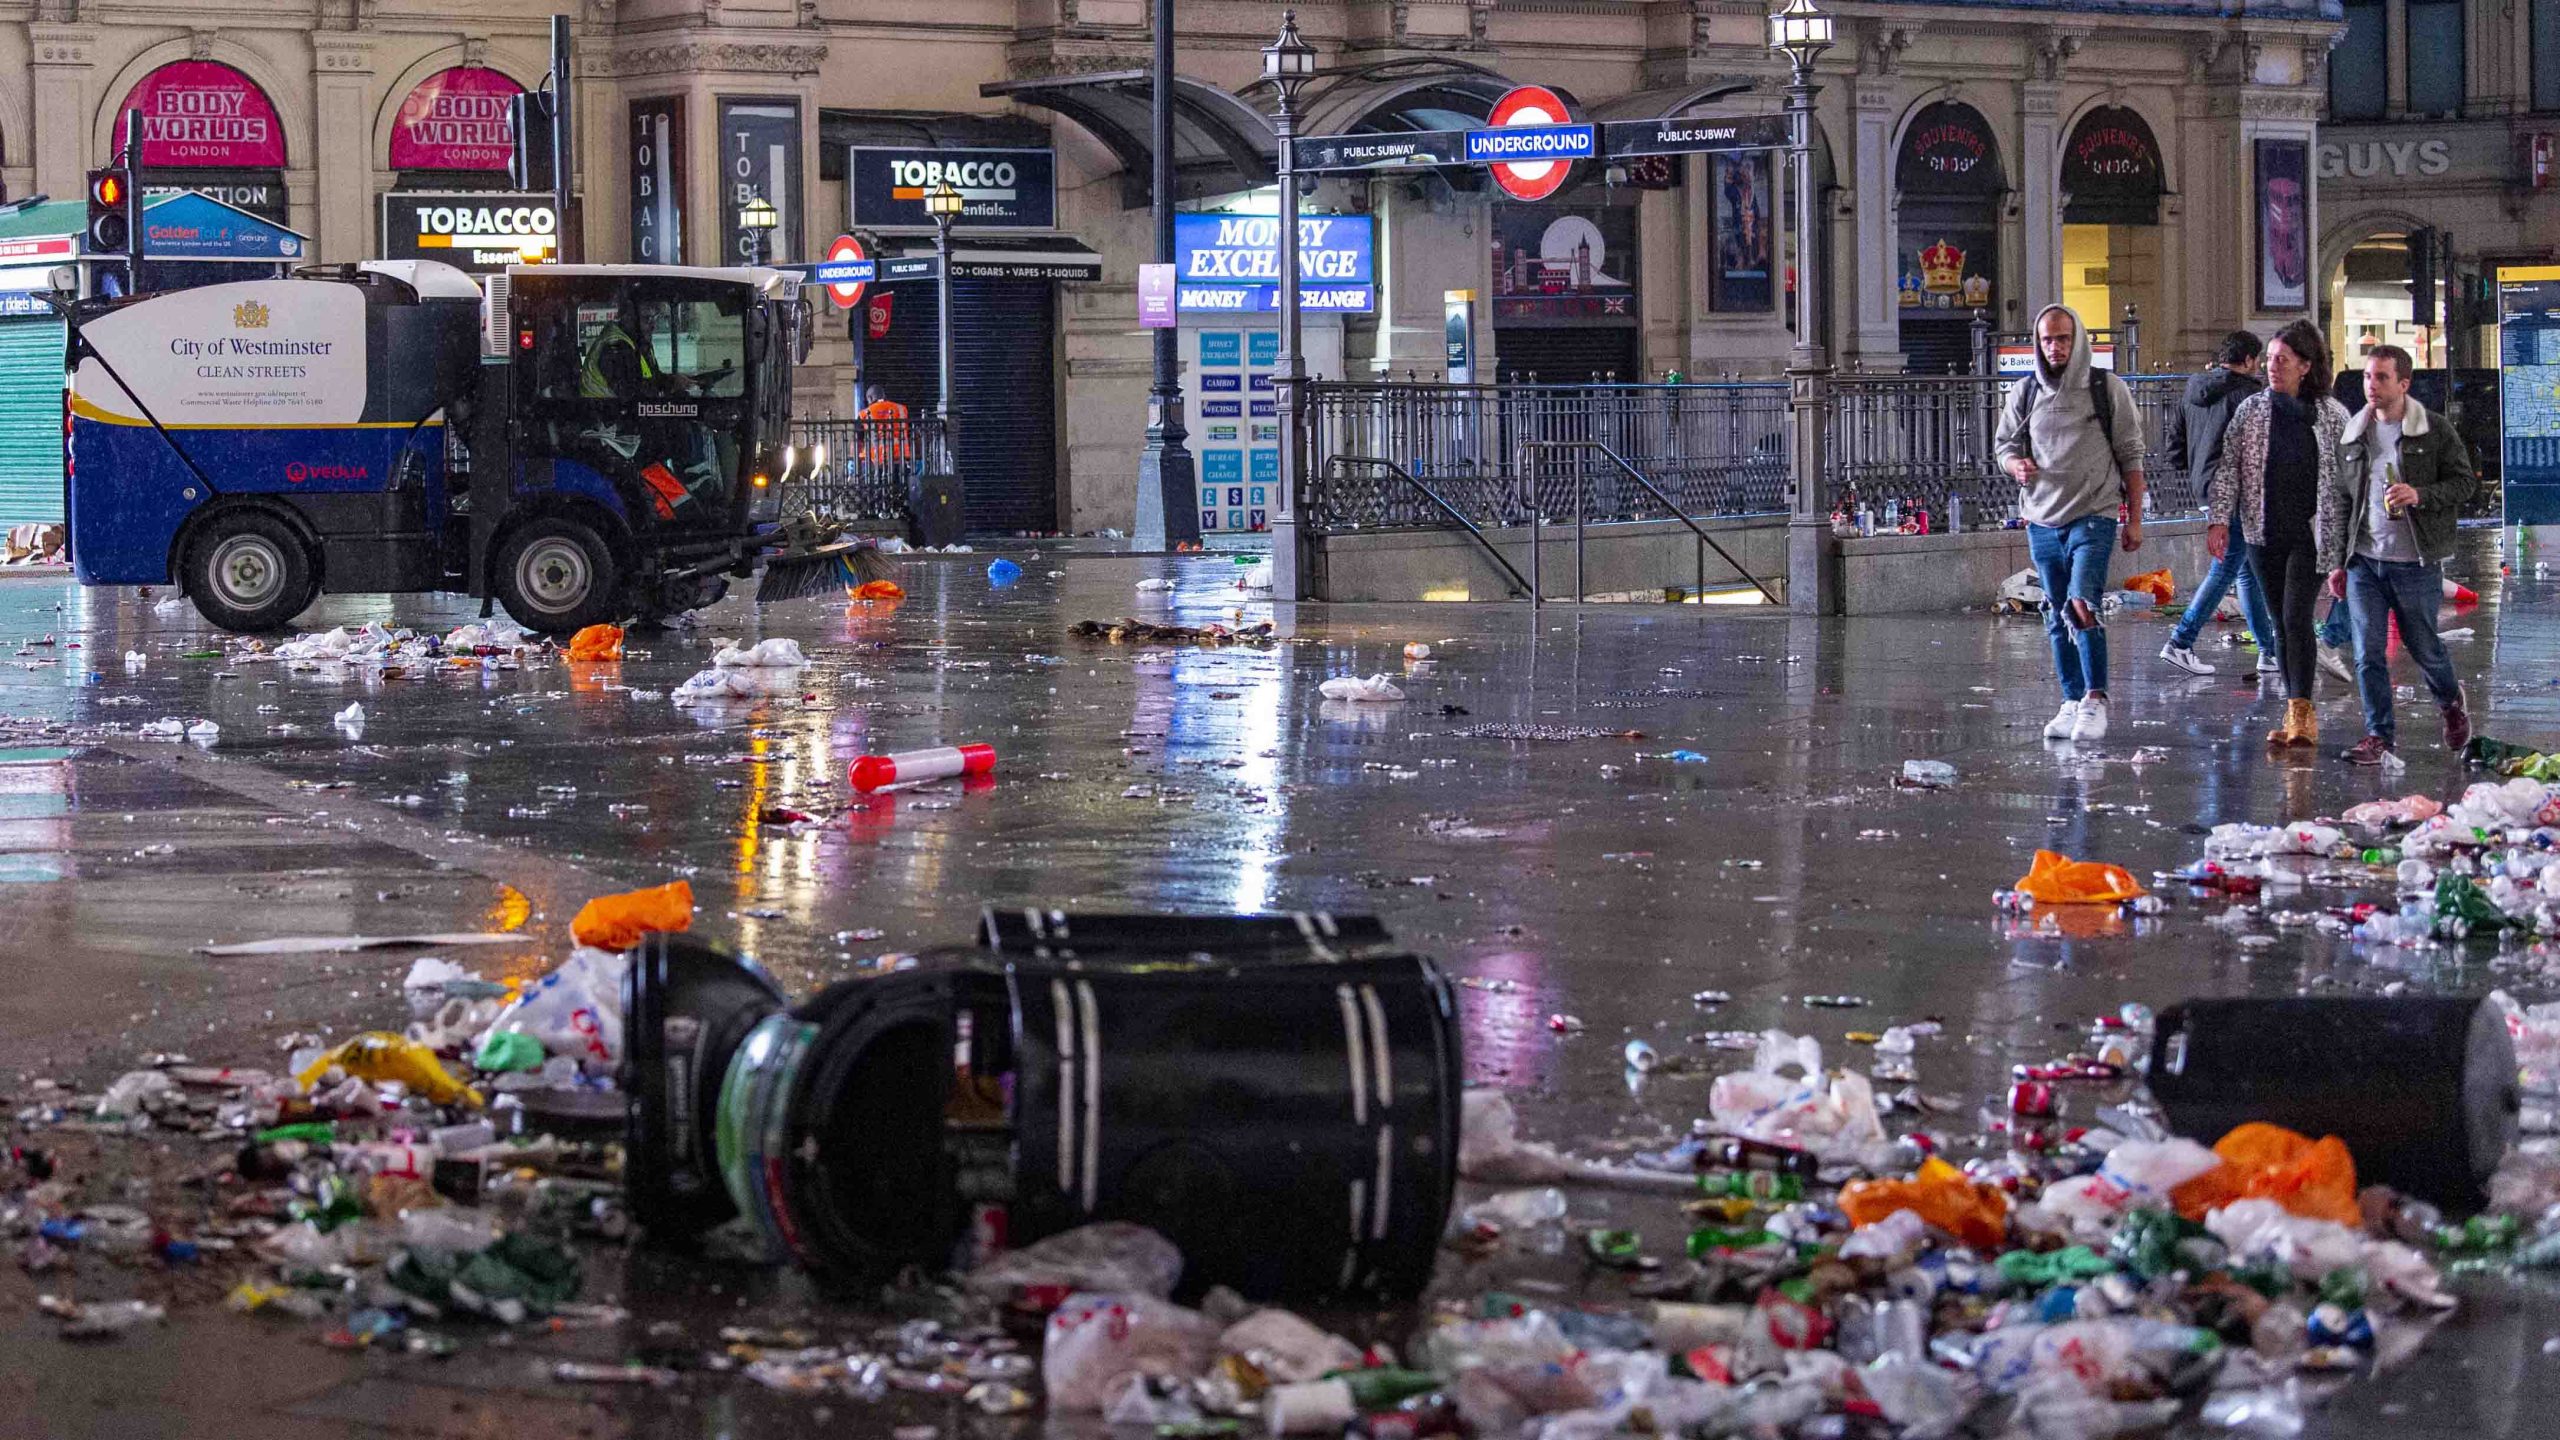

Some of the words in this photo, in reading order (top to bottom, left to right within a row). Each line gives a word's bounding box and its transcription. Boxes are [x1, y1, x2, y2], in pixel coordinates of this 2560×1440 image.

[157, 91, 246, 116] BODY
[432, 95, 512, 120] BODY
[142, 117, 267, 143] WORLDS
[410, 121, 515, 146] WORLD
[1657, 130, 1693, 142] PUBLIC
[1694, 128, 1736, 140] SUBWAY
[1471, 133, 1589, 153] UNDERGROUND
[1915, 125, 1985, 156] SOUVENIRS
[2079, 127, 2146, 160] SOUVENIRS
[171, 146, 230, 156] LONDON
[444, 150, 500, 160] LONDON
[1343, 147, 1376, 157] PUBLIC
[1377, 144, 1415, 156] SUBWAY
[2316, 139, 2450, 178] GUYS
[891, 161, 1016, 187] TOBACCO
[417, 207, 556, 235] TOBACCO
[891, 265, 908, 273] PUBLIC
[908, 263, 928, 272] SUBWAY
[1187, 249, 1359, 278] EXCHNGE
[819, 265, 873, 279] UNDERGROUND
[972, 266, 1003, 277] CIGARS
[1013, 267, 1039, 278] VAPES
[1047, 268, 1089, 279] E-LIQUIDS
[6, 296, 29, 311] tickets
[1180, 290, 1247, 308] MONEY
[1271, 291, 1367, 308] ECHANGE
[170, 338, 203, 360] City
[207, 338, 225, 355] of
[229, 338, 332, 355] Westminster
[1208, 340, 1233, 348] MONEY
[2010, 357, 2034, 366] Baker
[197, 366, 243, 378] CLEAN
[247, 366, 306, 378] STREETS
[1207, 379, 1235, 388] CAMBIO
[243, 399, 271, 408] Helpline
[638, 401, 698, 416] boschung
[1205, 405, 1239, 413] WECHSEL
[311, 466, 368, 480] VEOLIA
[1205, 490, 1214, 505] £
[1231, 489, 1240, 504] $
[1253, 489, 1261, 503] £
[1205, 512, 1214, 527] ¥
[1231, 512, 1240, 526] €
